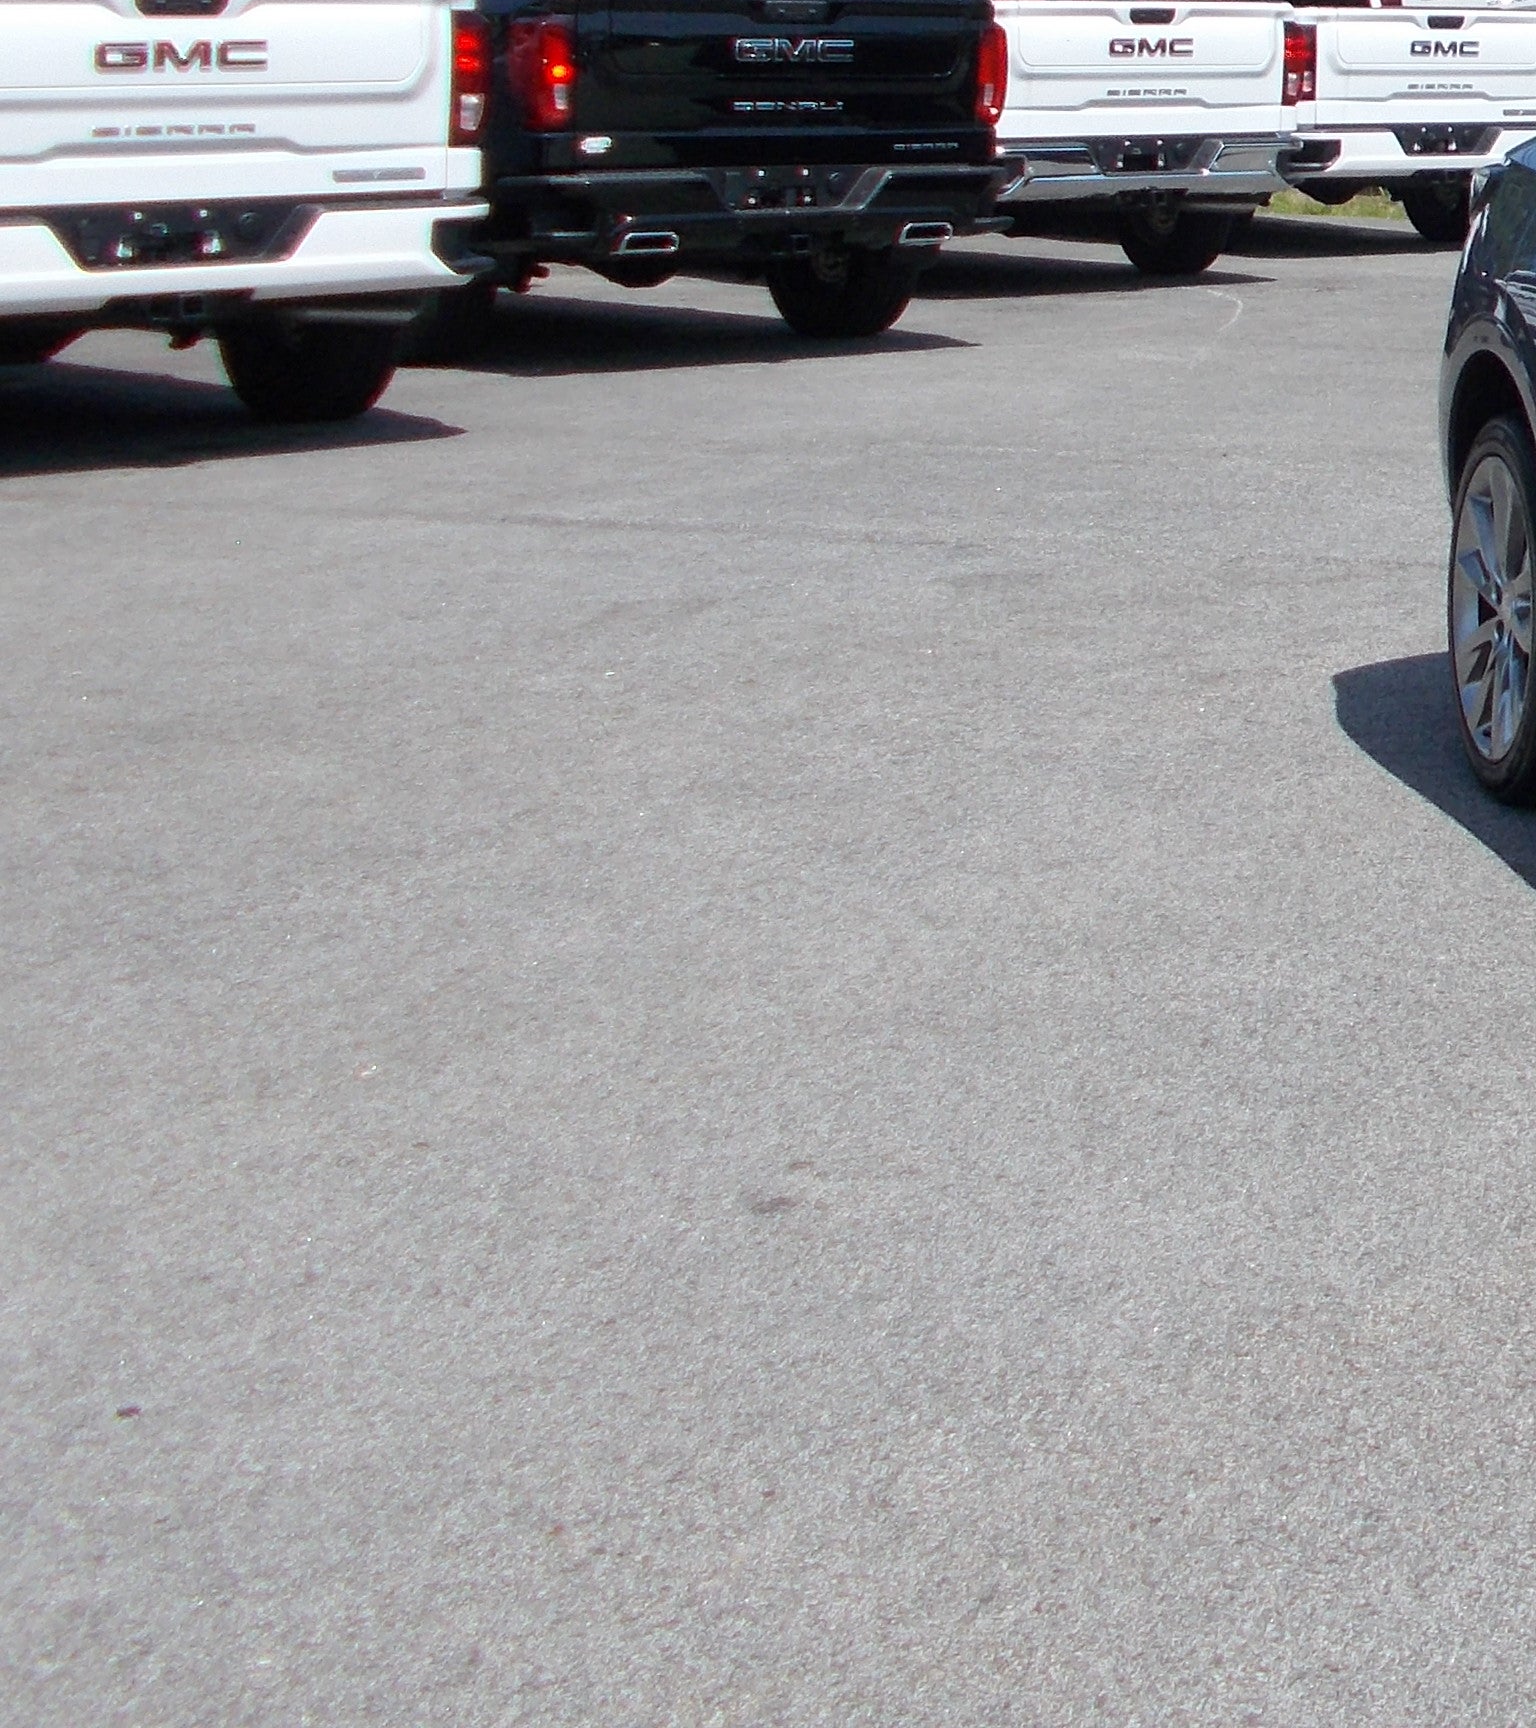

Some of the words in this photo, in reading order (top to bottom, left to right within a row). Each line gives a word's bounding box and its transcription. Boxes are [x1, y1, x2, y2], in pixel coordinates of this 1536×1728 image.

[94, 39, 269, 74] GMC
[735, 38, 855, 62] GMC
[1109, 38, 1194, 57] GMC
[1410, 40, 1480, 57] GMC
[92, 122, 256, 137] SIERRA
